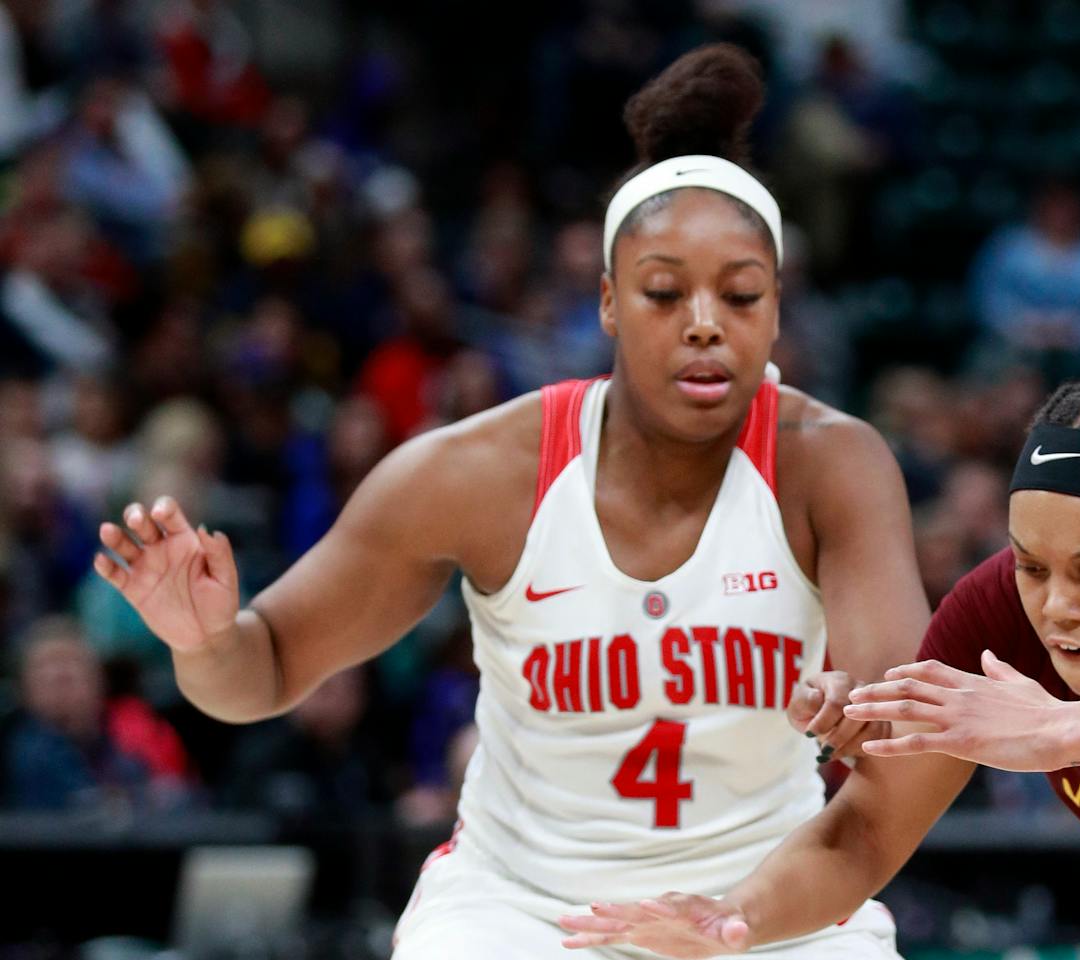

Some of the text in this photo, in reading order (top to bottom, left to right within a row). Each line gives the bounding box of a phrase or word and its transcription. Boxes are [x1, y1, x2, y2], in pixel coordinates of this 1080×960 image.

[522, 625, 804, 713] OHIO STATE
[610, 716, 694, 829] 4
